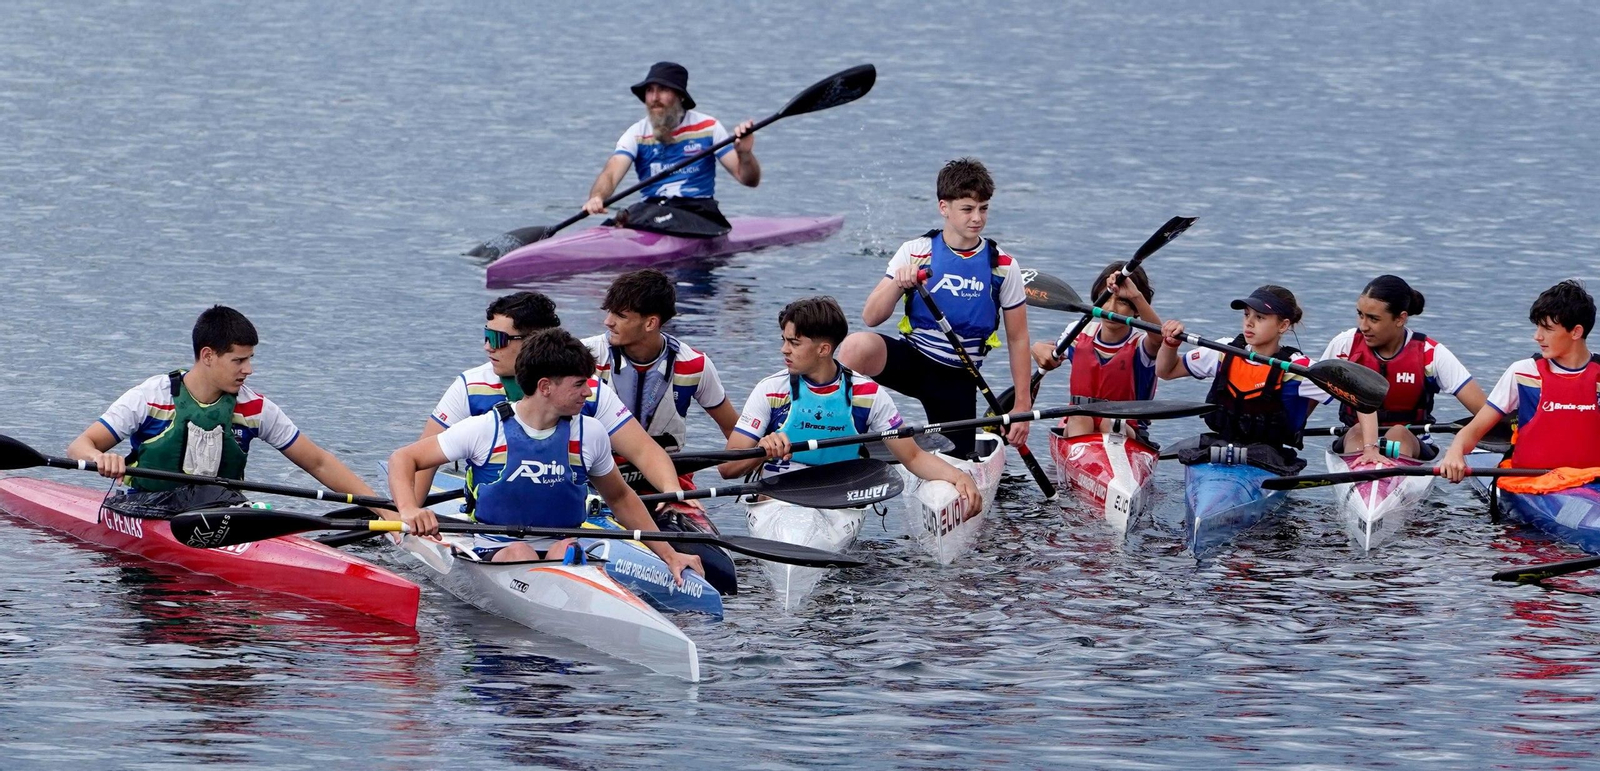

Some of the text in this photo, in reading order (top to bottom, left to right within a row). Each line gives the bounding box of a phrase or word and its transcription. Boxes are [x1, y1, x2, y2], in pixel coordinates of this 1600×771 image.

[1396, 372, 1415, 384] HH
[615, 558, 631, 575] CLUB
[510, 580, 529, 593] NELO
